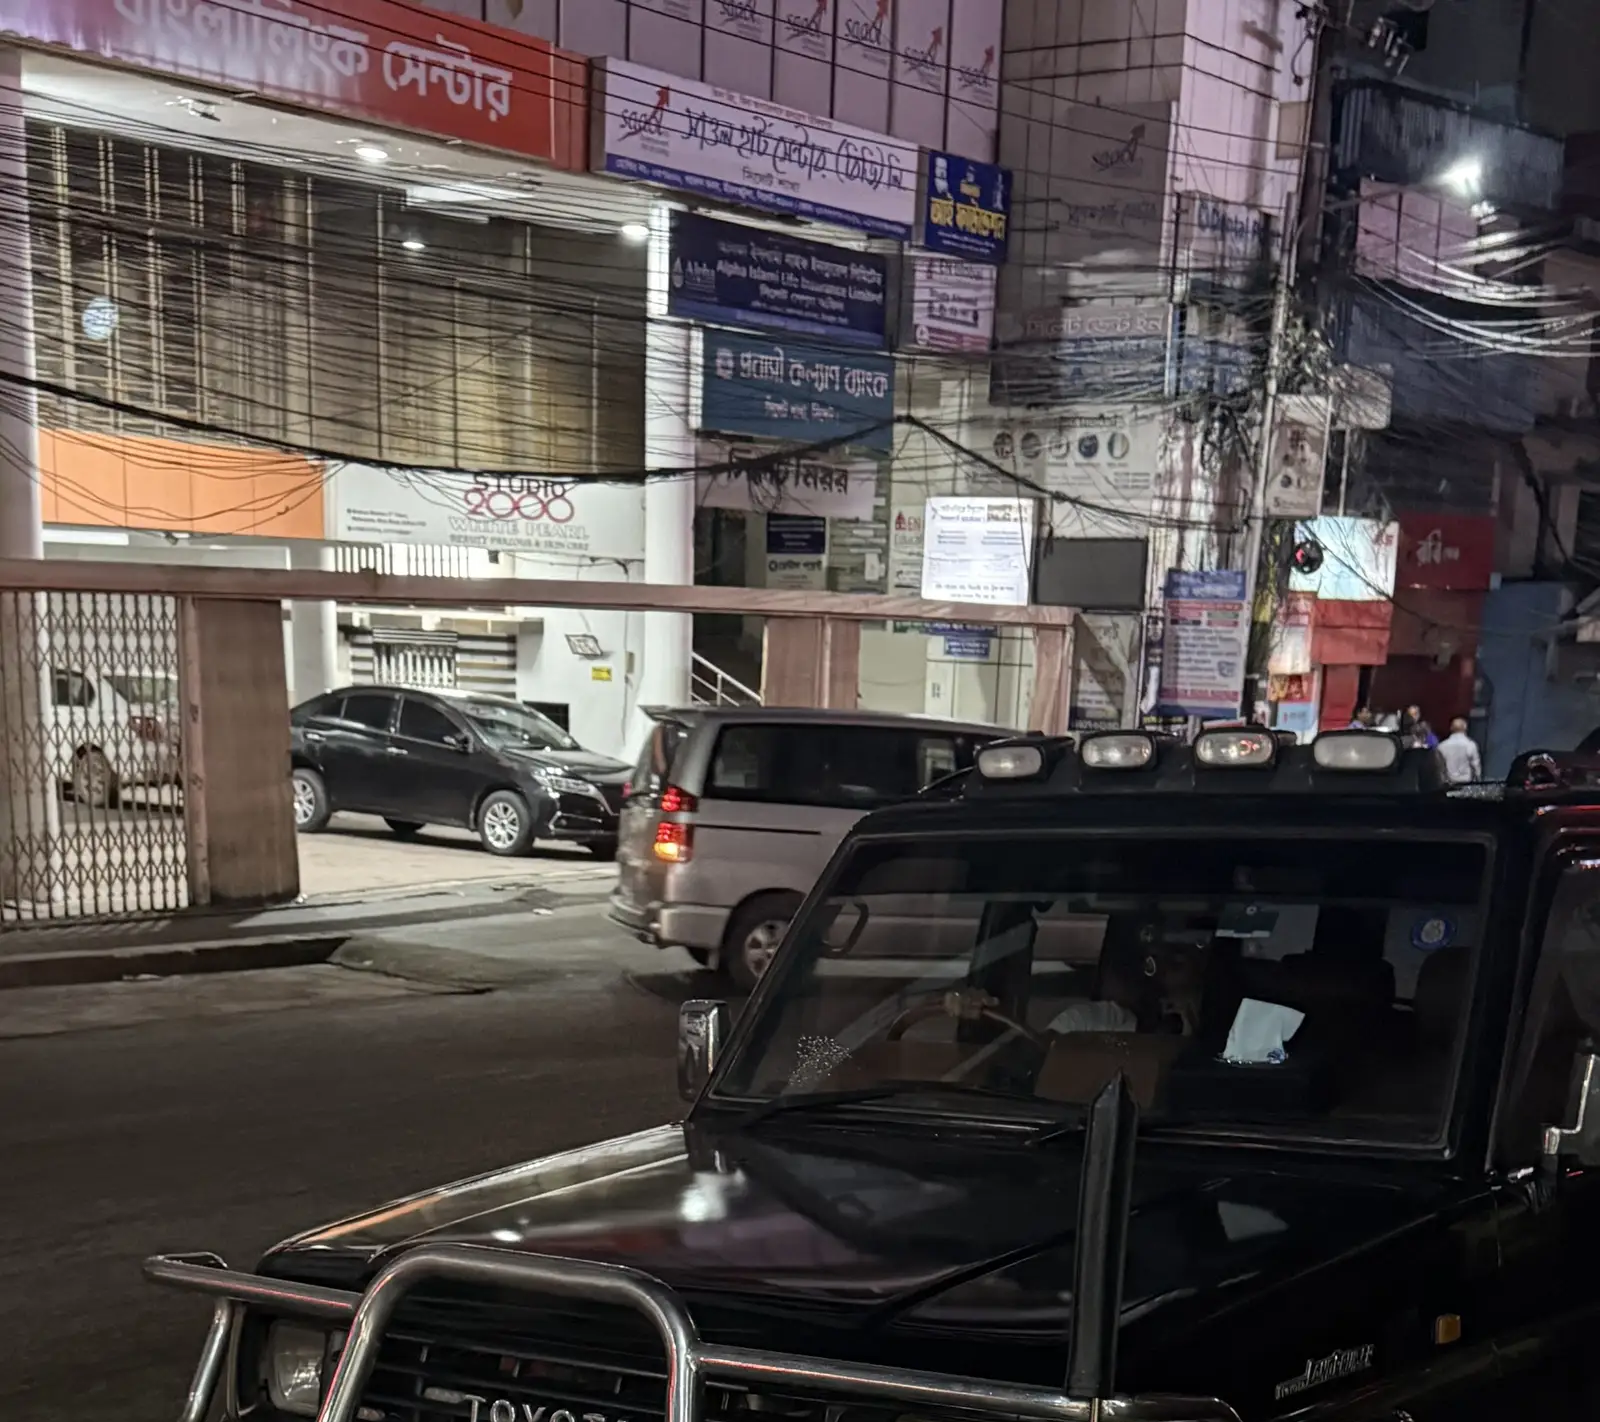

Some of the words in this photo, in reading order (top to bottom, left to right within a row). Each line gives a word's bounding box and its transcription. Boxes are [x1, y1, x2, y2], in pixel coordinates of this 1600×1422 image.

[383, 34, 514, 122] সেন্টার
[740, 346, 785, 384] প্রবাসী
[788, 358, 841, 392] কল্যাণ
[844, 366, 890, 398] ব্যাংক
[474, 472, 566, 499] STUDIO
[464, 488, 575, 523] 2000
[448, 516, 520, 535] WHITE
[525, 522, 590, 540] PEARL
